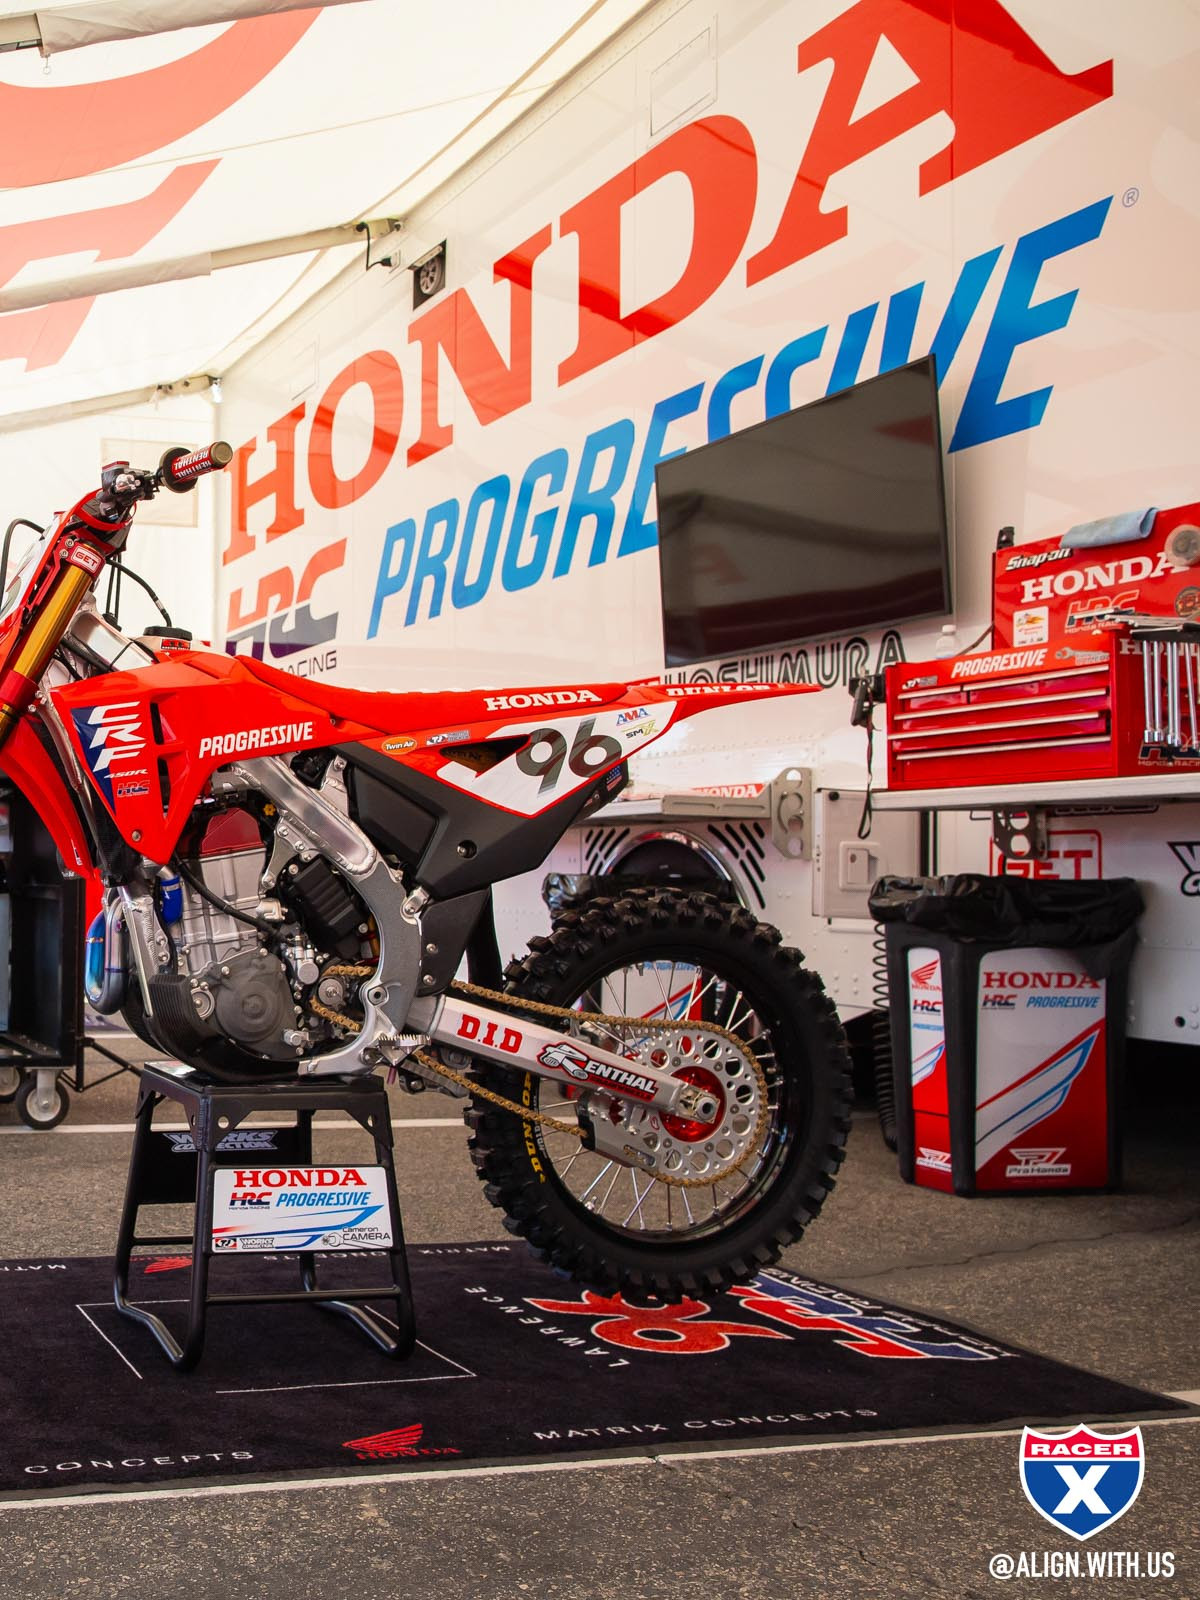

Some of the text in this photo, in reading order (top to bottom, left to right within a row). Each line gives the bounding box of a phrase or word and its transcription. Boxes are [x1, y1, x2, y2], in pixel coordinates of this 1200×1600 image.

[223, 0, 1114, 566] HONDA
[75, 551, 98, 566] GET
[1006, 549, 1071, 571] Snap-on
[1020, 552, 1191, 604] HONDA
[280, 650, 337, 679] ACING
[664, 632, 907, 690] HIMURA
[951, 648, 1048, 679] PROGRESSIVE
[483, 690, 602, 711] HONDA
[617, 708, 649, 726] AMA
[199, 721, 314, 759] PROGRESSIVE
[385, 743, 402, 751] Twin
[515, 717, 623, 795] 96
[104, 768, 149, 779] 450R
[695, 784, 759, 799] ONDA
[983, 971, 1101, 989] HONDA
[913, 999, 942, 1013] HRC
[982, 994, 1100, 1009] HRC PROGRESSIVE
[457, 1013, 523, 1053] D.I.D
[537, 1042, 657, 1095] RENTHAL
[521, 1072, 544, 1173] DUNOP
[233, 1168, 367, 1188] HONDA
[229, 1191, 372, 1207] HRC PROGRESSIVE
[240, 1237, 275, 1246] WORKS
[343, 1232, 391, 1241] CAMERA
[464, 1286, 631, 1369] LAWRENCE
[533, 1407, 879, 1440] MATRIX CONCEPTS
[24, 1450, 255, 1475] CONCEPTS
